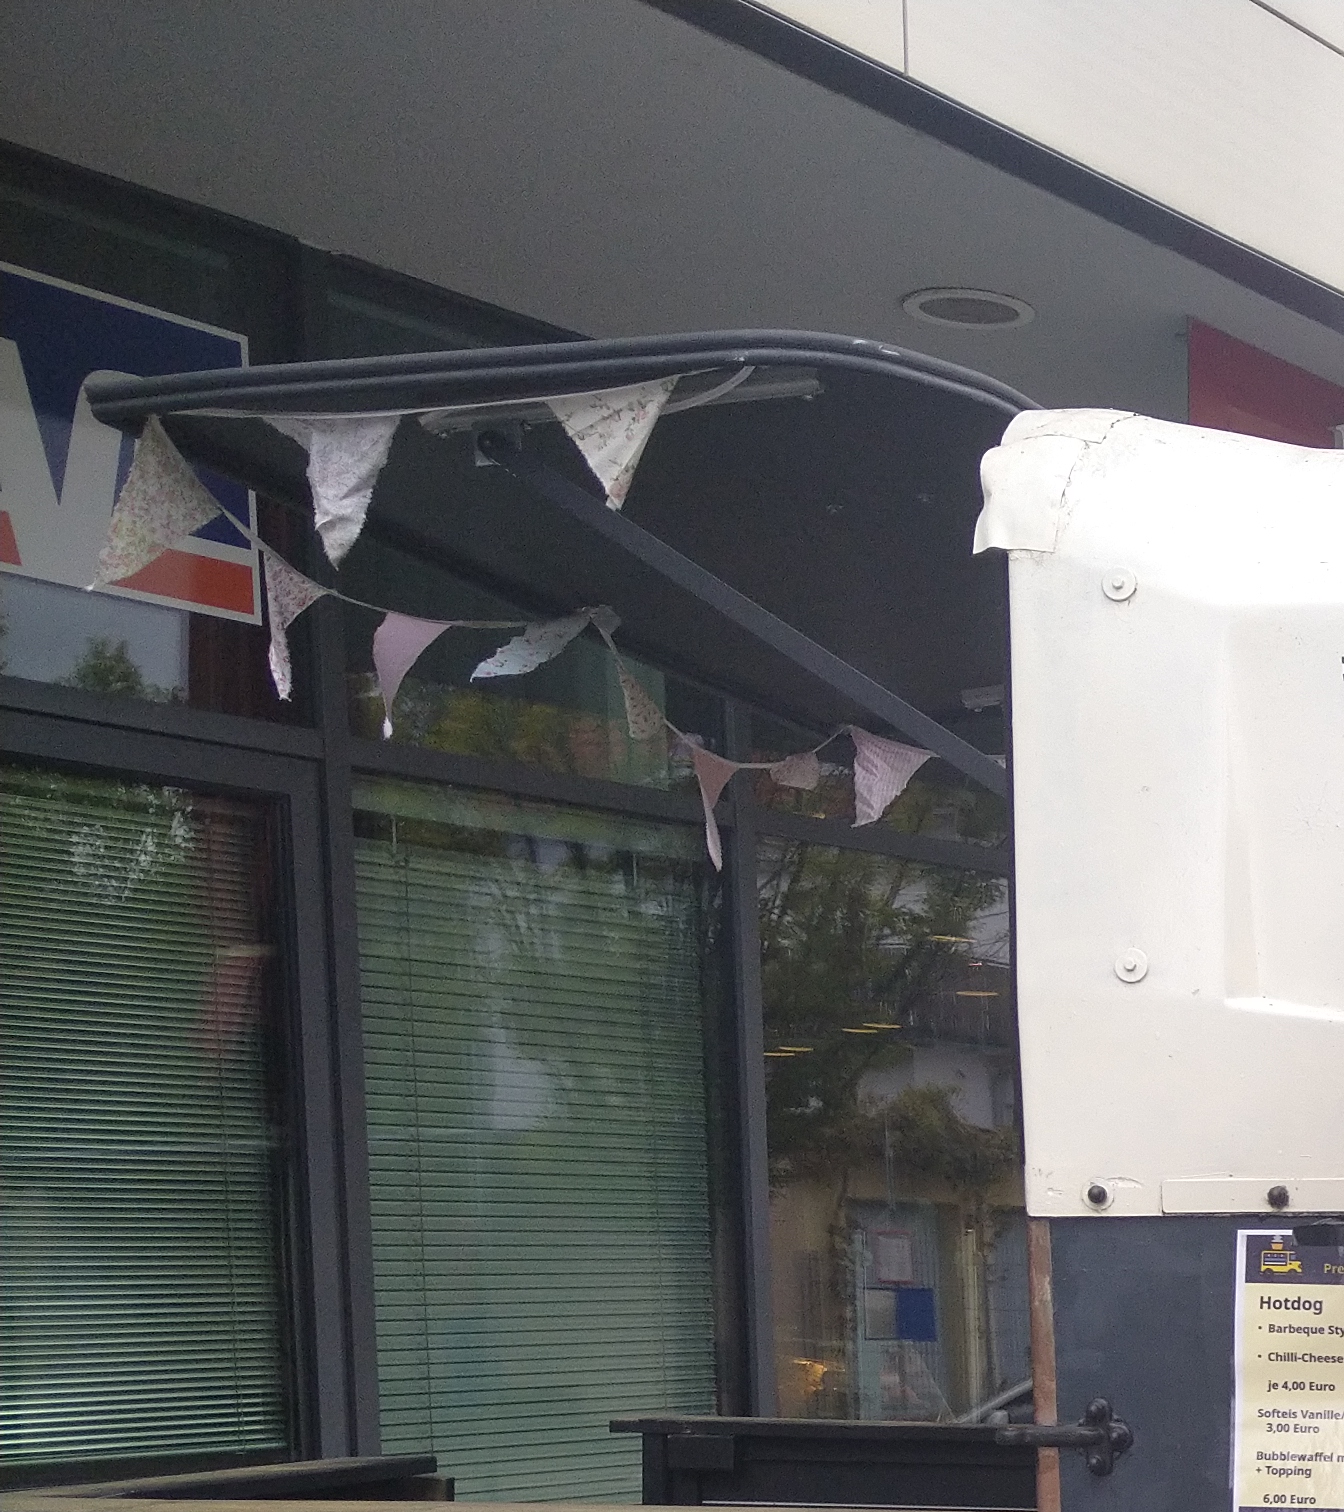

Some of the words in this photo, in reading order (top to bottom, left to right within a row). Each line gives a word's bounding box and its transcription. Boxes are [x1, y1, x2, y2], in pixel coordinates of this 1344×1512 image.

[1259, 1295, 1323, 1315] Hotdog
[1268, 1324, 1325, 1337] Barbeque
[1267, 1352, 1344, 1365] Chilli-Cheese
[1267, 1379, 1279, 1392] je
[1281, 1381, 1306, 1393] 4,00
[1308, 1382, 1336, 1393] Euro
[1257, 1408, 1298, 1420] Softeis
[1265, 1423, 1290, 1435] 3,00
[1293, 1424, 1320, 1435] Euro
[1255, 1450, 1334, 1464] Bubblewaffel
[1264, 1465, 1312, 1479] Topping
[1262, 1494, 1287, 1506] 6,00
[1290, 1494, 1317, 1506] Euro
